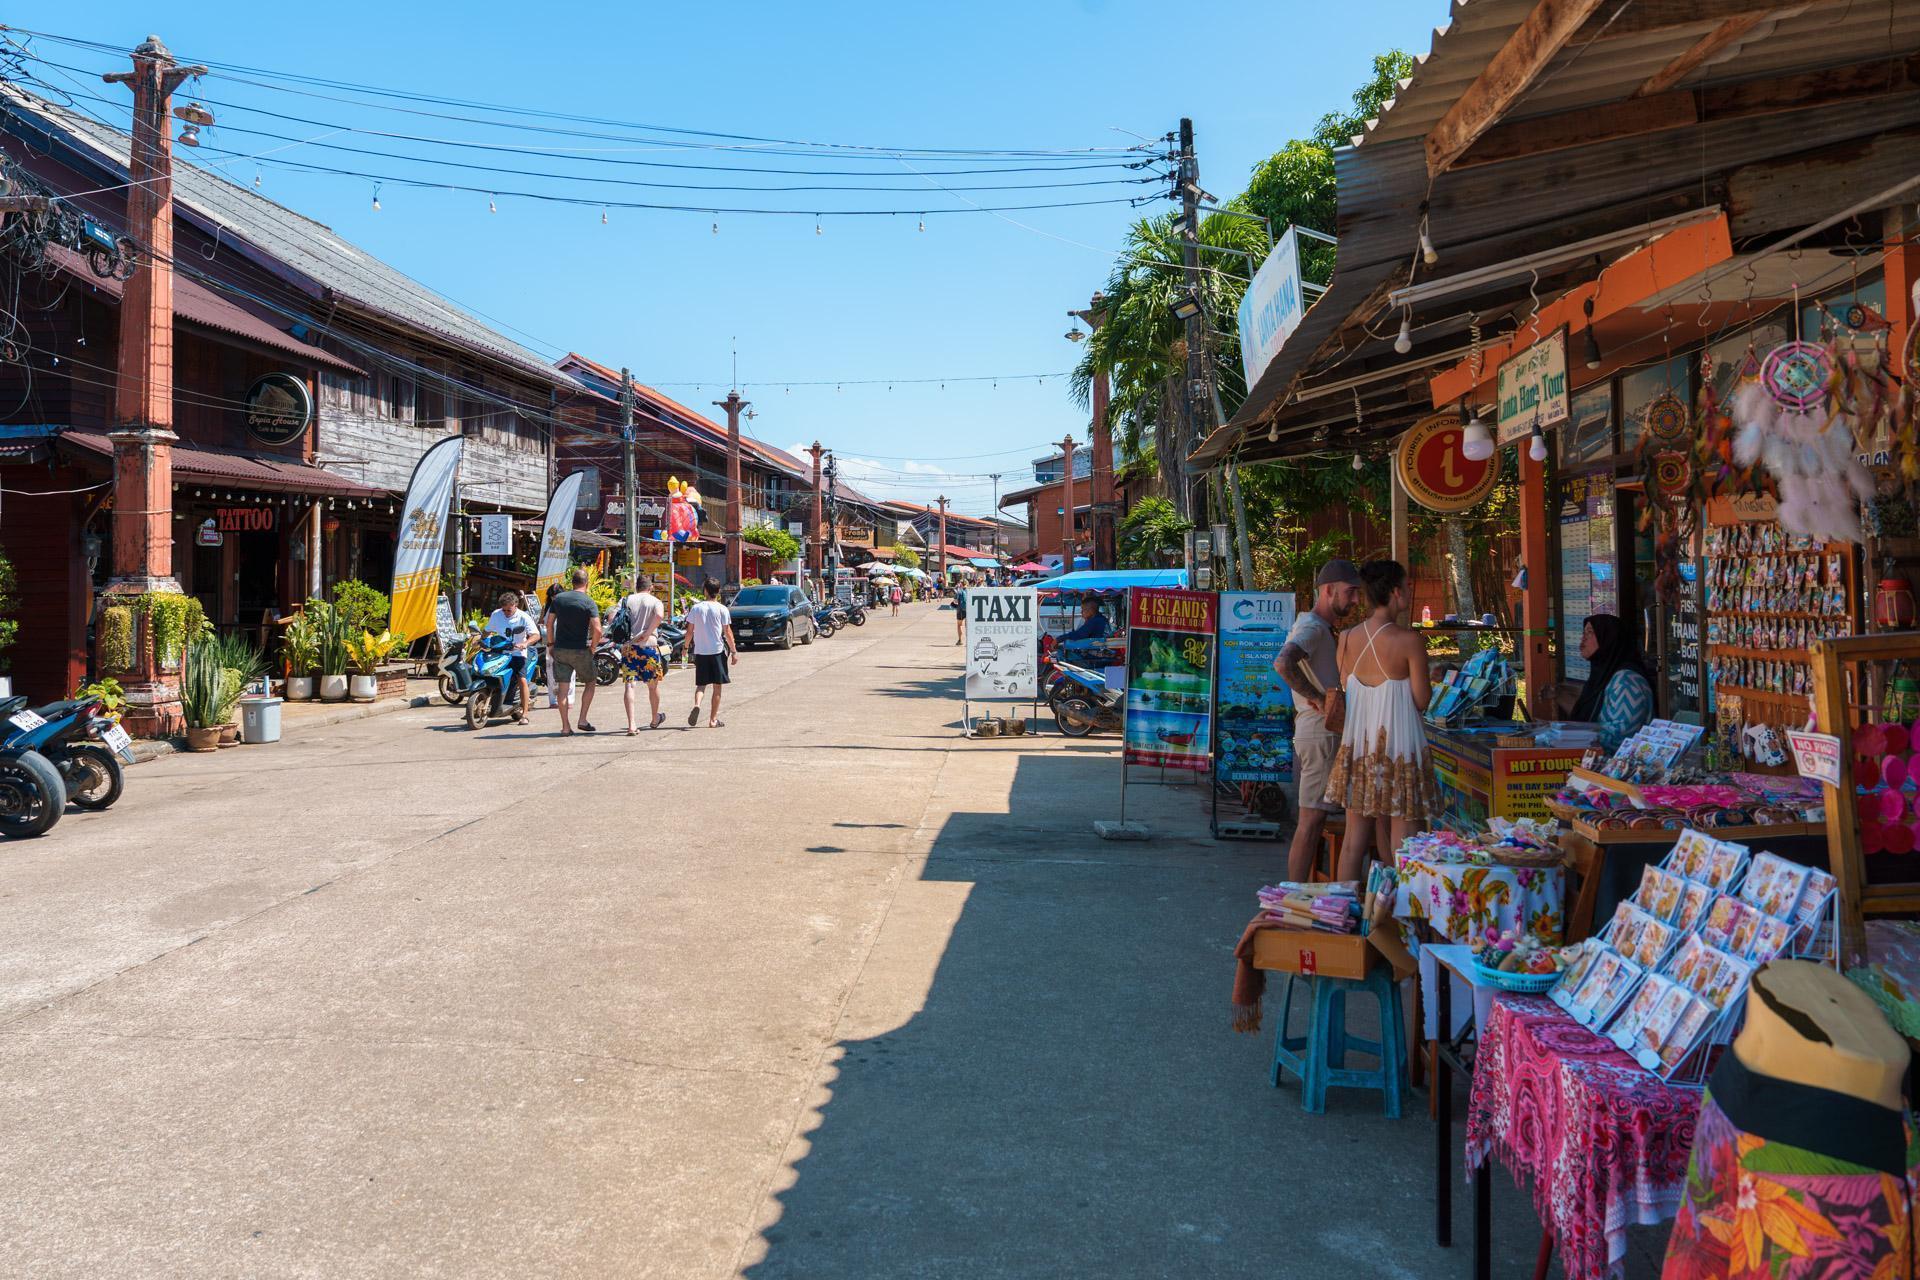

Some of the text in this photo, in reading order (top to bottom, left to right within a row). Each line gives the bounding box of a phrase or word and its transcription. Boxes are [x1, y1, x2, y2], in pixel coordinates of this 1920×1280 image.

[1542, 371, 1565, 401] Tour
[1408, 433, 1424, 471] TOURIST
[217, 508, 273, 530] TATTOO
[971, 595, 1032, 622] TAXI
[1139, 597, 1208, 619] 4 ISLANDS
[974, 625, 1033, 635] SERVICE
[1141, 614, 1151, 623] BY
[1153, 616, 1186, 626] LONGTAIL
[1797, 739, 1811, 750] NO
[1510, 757, 1581, 773] HOT TOURS
